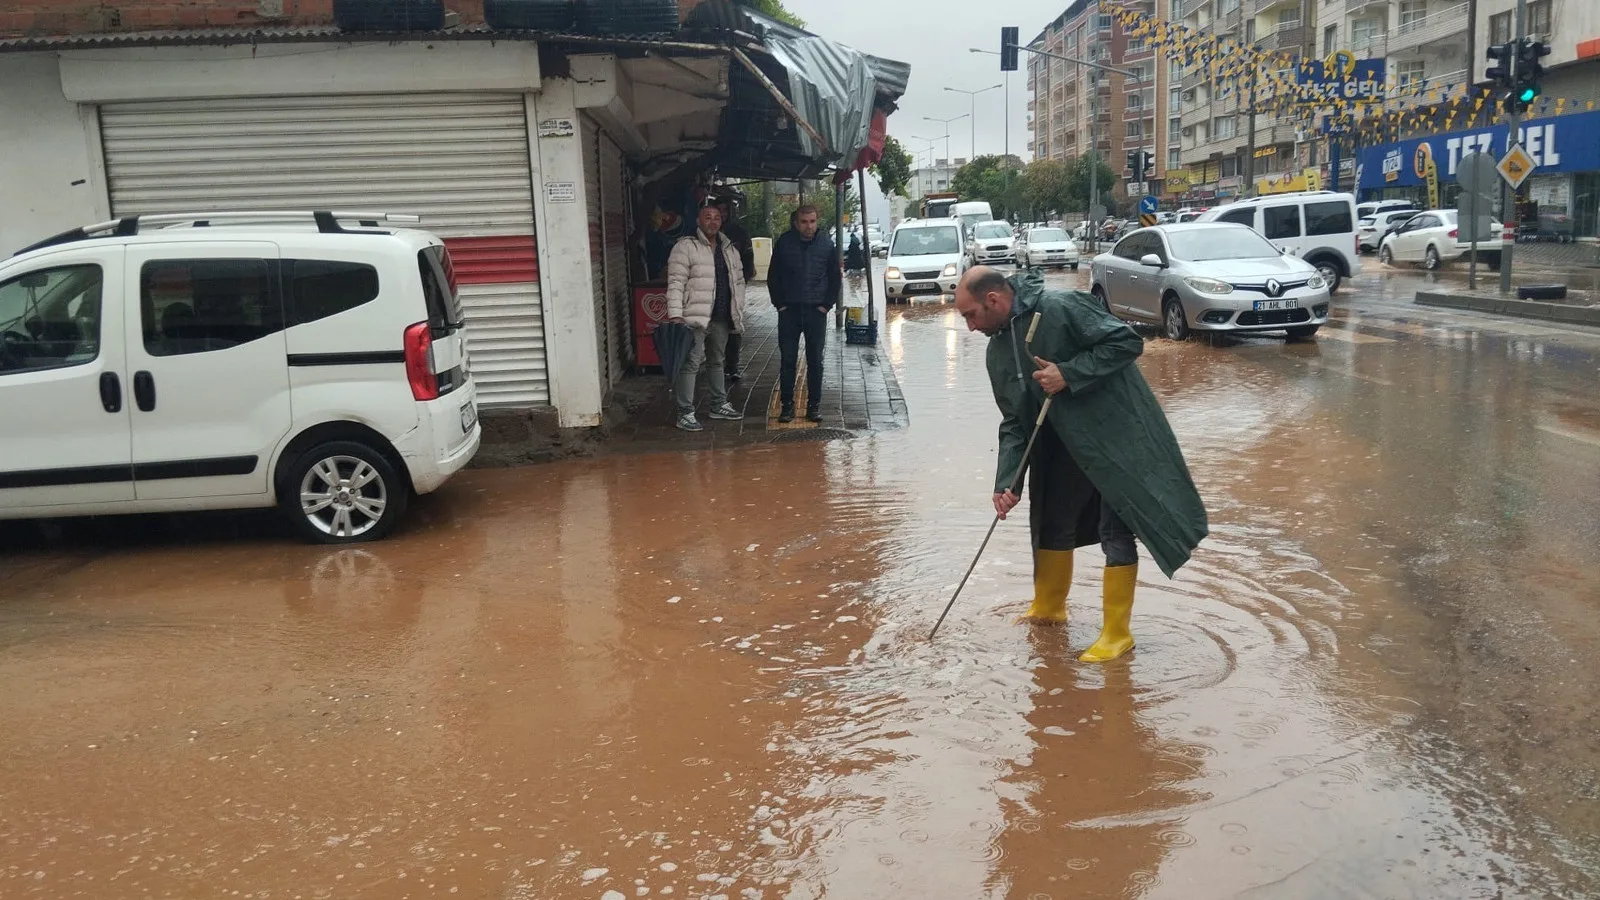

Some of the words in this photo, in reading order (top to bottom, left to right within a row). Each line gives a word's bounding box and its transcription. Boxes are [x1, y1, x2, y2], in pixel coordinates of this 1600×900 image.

[1299, 82, 1340, 99] TEZ
[1344, 80, 1385, 98] GEL
[1258, 302, 1266, 310] 21
[1286, 300, 1297, 309] 801
